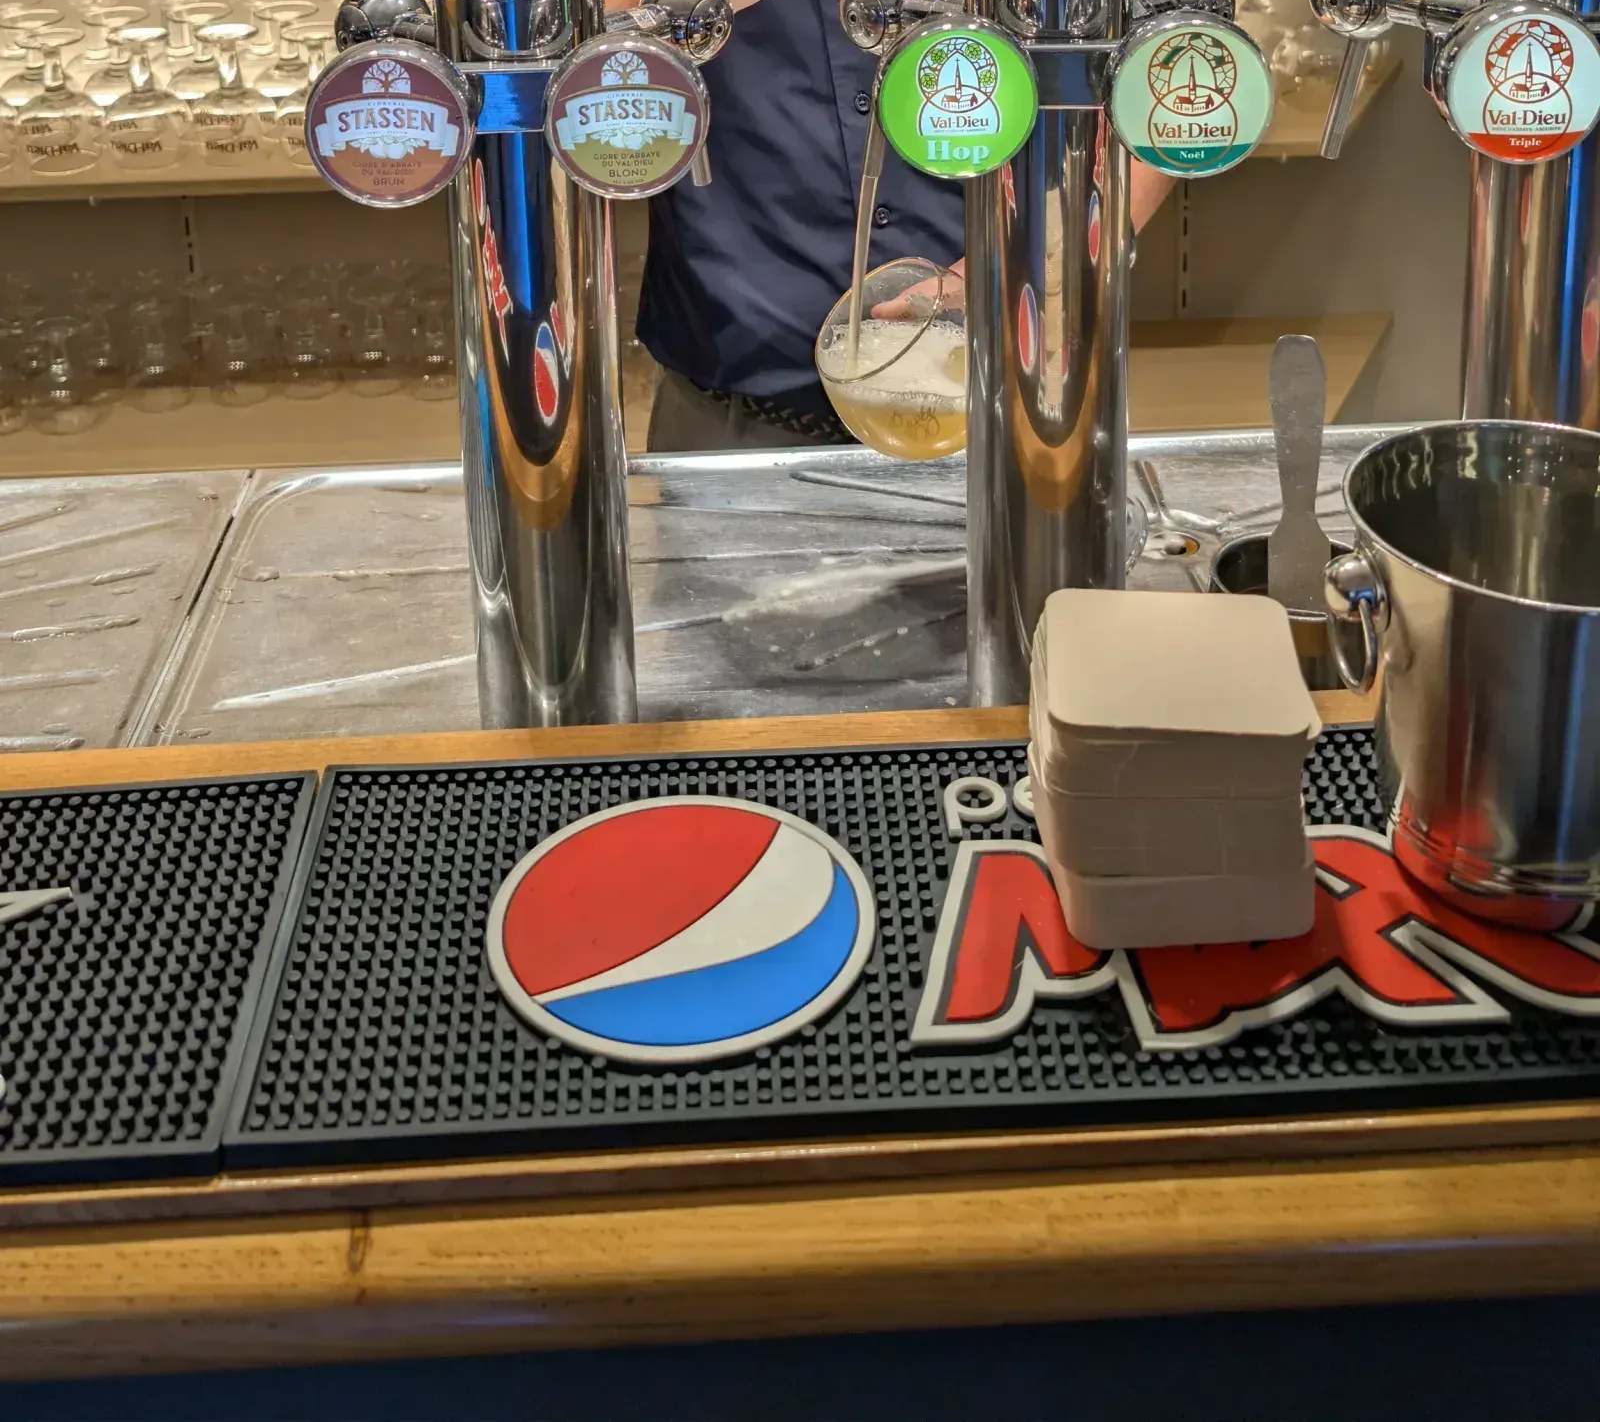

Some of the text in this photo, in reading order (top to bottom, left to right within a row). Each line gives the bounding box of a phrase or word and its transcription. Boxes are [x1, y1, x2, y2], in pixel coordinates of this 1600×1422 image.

[578, 98, 673, 126] STASSEN
[1487, 109, 1567, 126] Val-Dieu
[337, 107, 435, 133] STASSEN
[929, 115, 989, 129] Val-Dieu
[1152, 122, 1232, 139] Val-Dieu
[1509, 138, 1542, 148] Triple
[621, 151, 661, 159] D'ABBAYE
[926, 140, 990, 165] Hop
[1180, 150, 1205, 159] Noël
[609, 168, 648, 178] BLOND
[373, 178, 405, 186] BRUN
